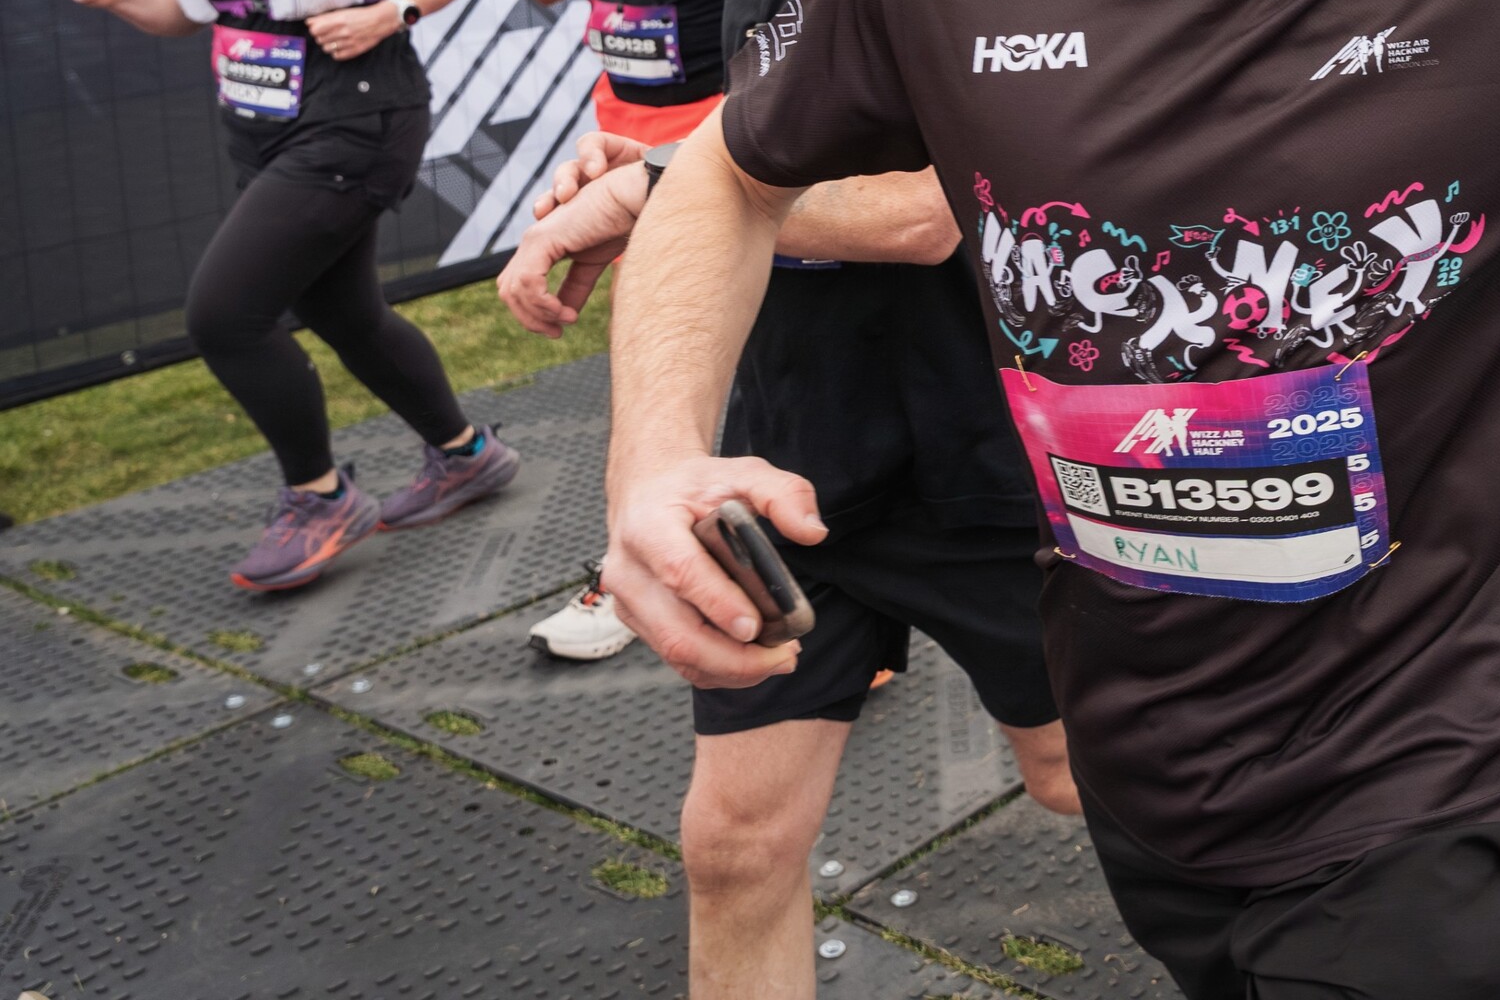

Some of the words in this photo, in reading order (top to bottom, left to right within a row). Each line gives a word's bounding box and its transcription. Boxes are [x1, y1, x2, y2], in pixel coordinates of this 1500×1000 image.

[1386, 40, 1411, 50] WIZZ
[1413, 38, 1430, 47] AIR
[972, 31, 1088, 73] HOKA
[1387, 46, 1430, 57] HACKNEY
[1388, 55, 1412, 64] HALF
[1437, 257, 1463, 271] 20
[1436, 272, 1461, 287] 25
[1267, 407, 1364, 439] 2025
[1190, 430, 1221, 439] WIZZ
[1223, 429, 1244, 438] AIR
[1192, 438, 1245, 447] HACKNEY
[1193, 447, 1223, 456] HALF
[1109, 472, 1334, 511] B13599
[1143, 512, 1198, 522] EMERGENCY
[1113, 536, 1199, 572] RYAN
